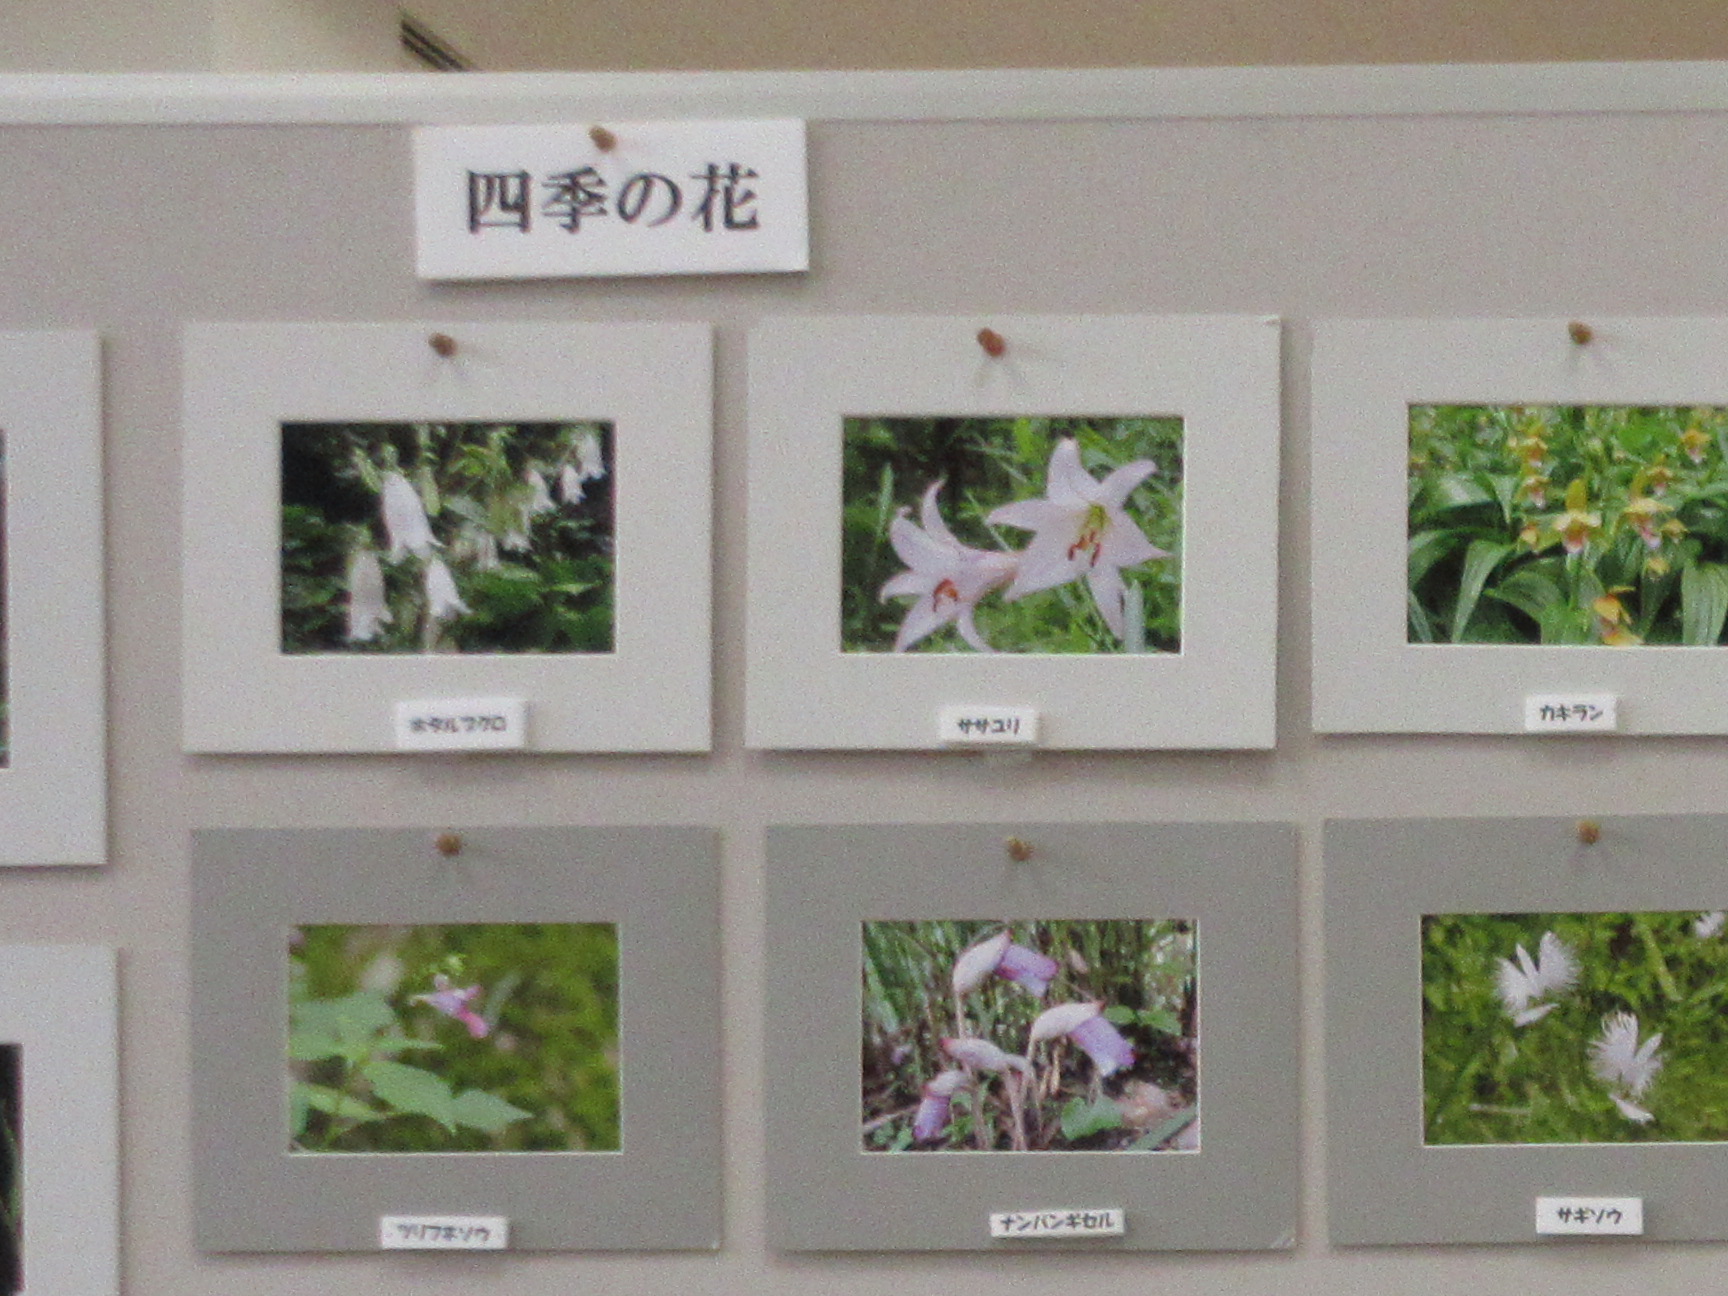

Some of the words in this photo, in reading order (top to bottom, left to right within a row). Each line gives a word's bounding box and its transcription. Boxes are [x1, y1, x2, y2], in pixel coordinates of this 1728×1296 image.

[466, 162, 760, 234] 四季の花
[1539, 703, 1604, 722] カキラン
[957, 717, 1020, 736] ササユリ
[1001, 1211, 1114, 1232] ナンバンギセル
[1556, 1207, 1623, 1226] サギソウ
